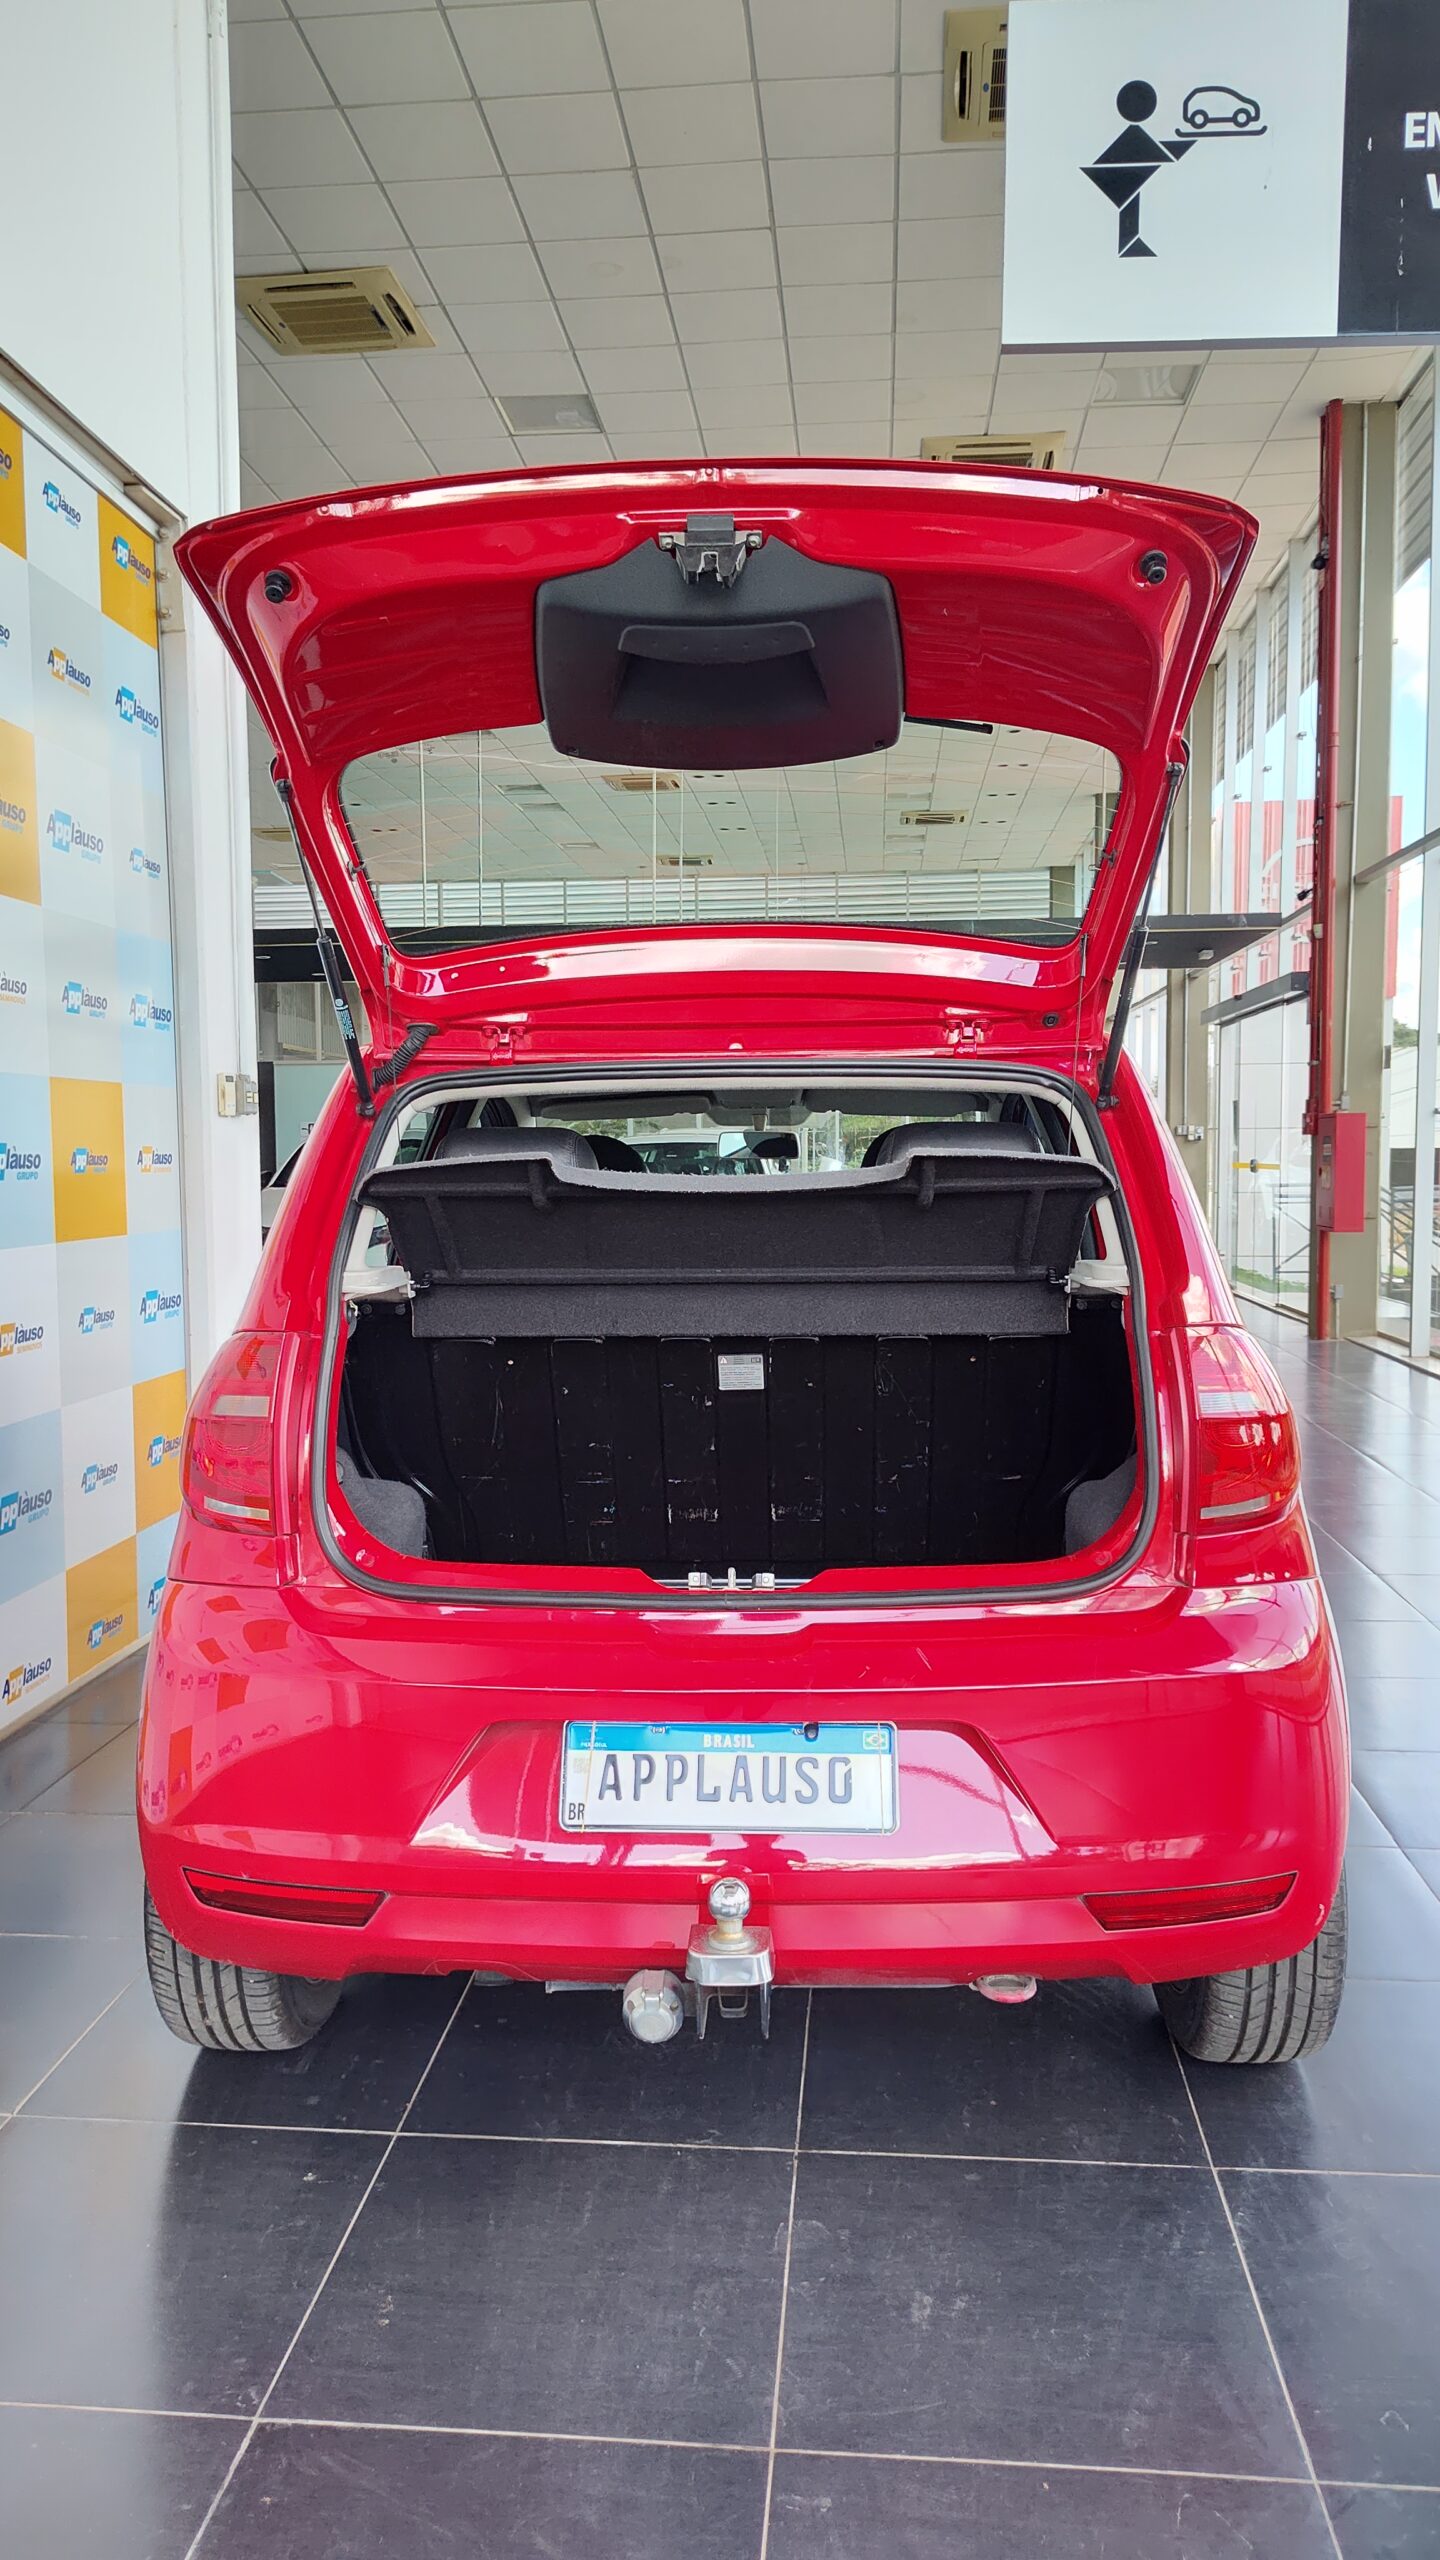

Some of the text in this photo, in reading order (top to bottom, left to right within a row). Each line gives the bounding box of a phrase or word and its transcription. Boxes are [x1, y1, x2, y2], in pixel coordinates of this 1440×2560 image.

[17, 1171, 38, 1180] GRUPO
[703, 1734, 755, 1749] BRASIL
[598, 1753, 854, 1805] APPLAUSO
[568, 1803, 585, 1820] BR
